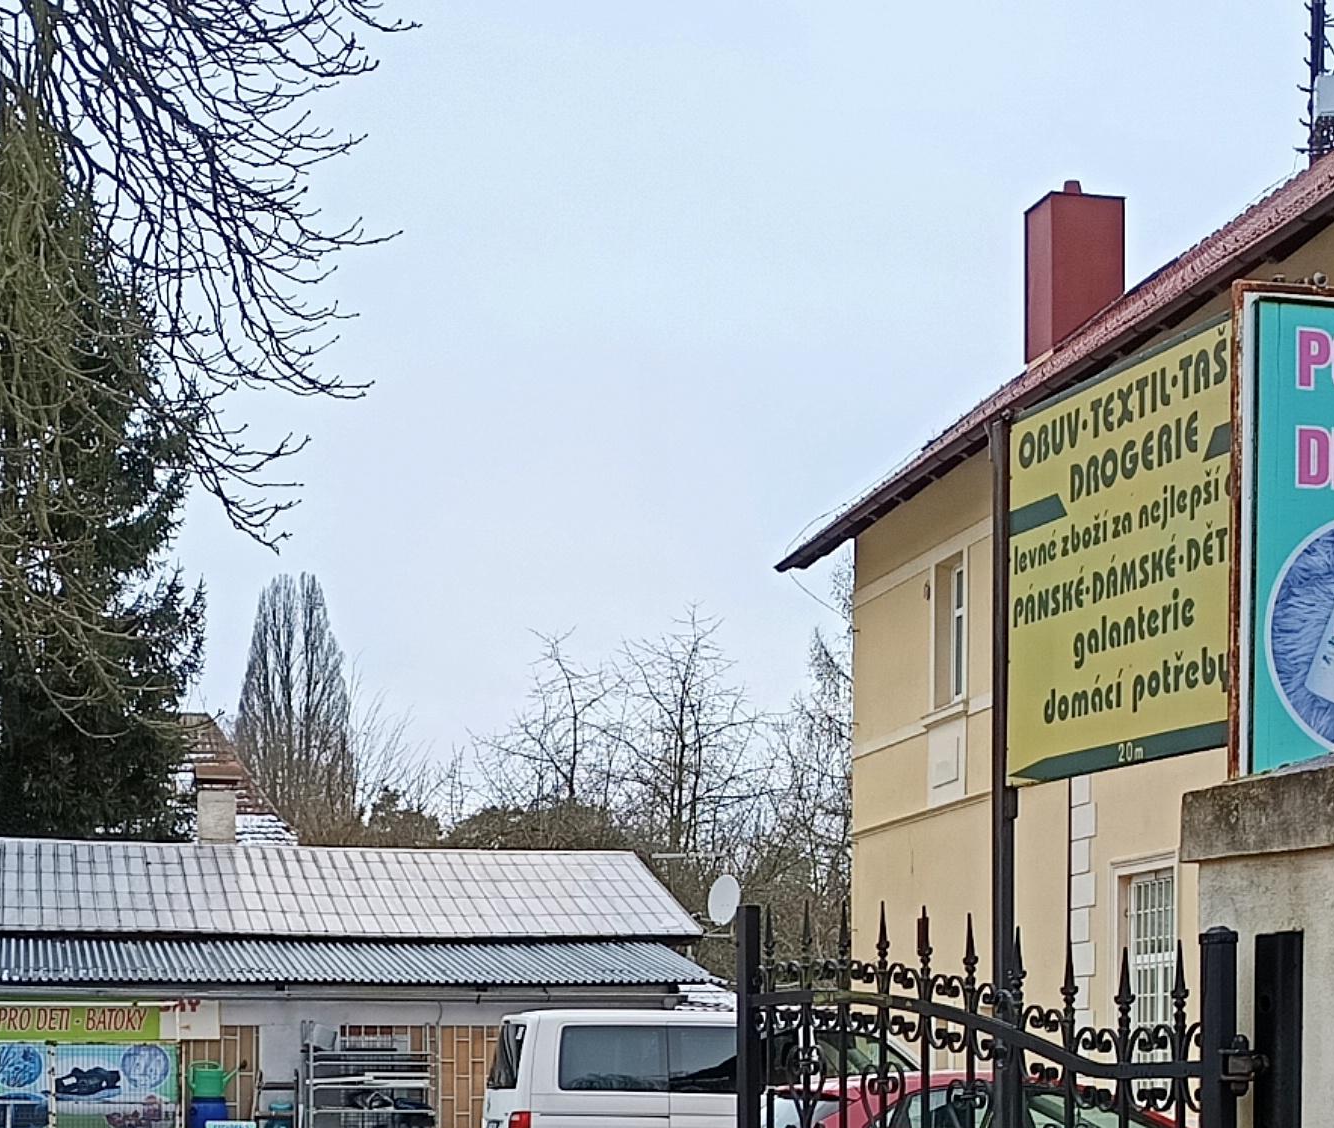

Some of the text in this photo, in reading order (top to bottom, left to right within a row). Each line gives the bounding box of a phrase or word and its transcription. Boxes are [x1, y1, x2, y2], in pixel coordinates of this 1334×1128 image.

[1070, 411, 1199, 503] DROGERIE
[1013, 528, 1058, 576] levné
[1061, 511, 1108, 559] zboží
[1112, 513, 1132, 541] za
[1138, 465, 1221, 532] nejlepší
[1073, 587, 1195, 670] galanterie
[1044, 646, 1229, 725] domácí potřeby
